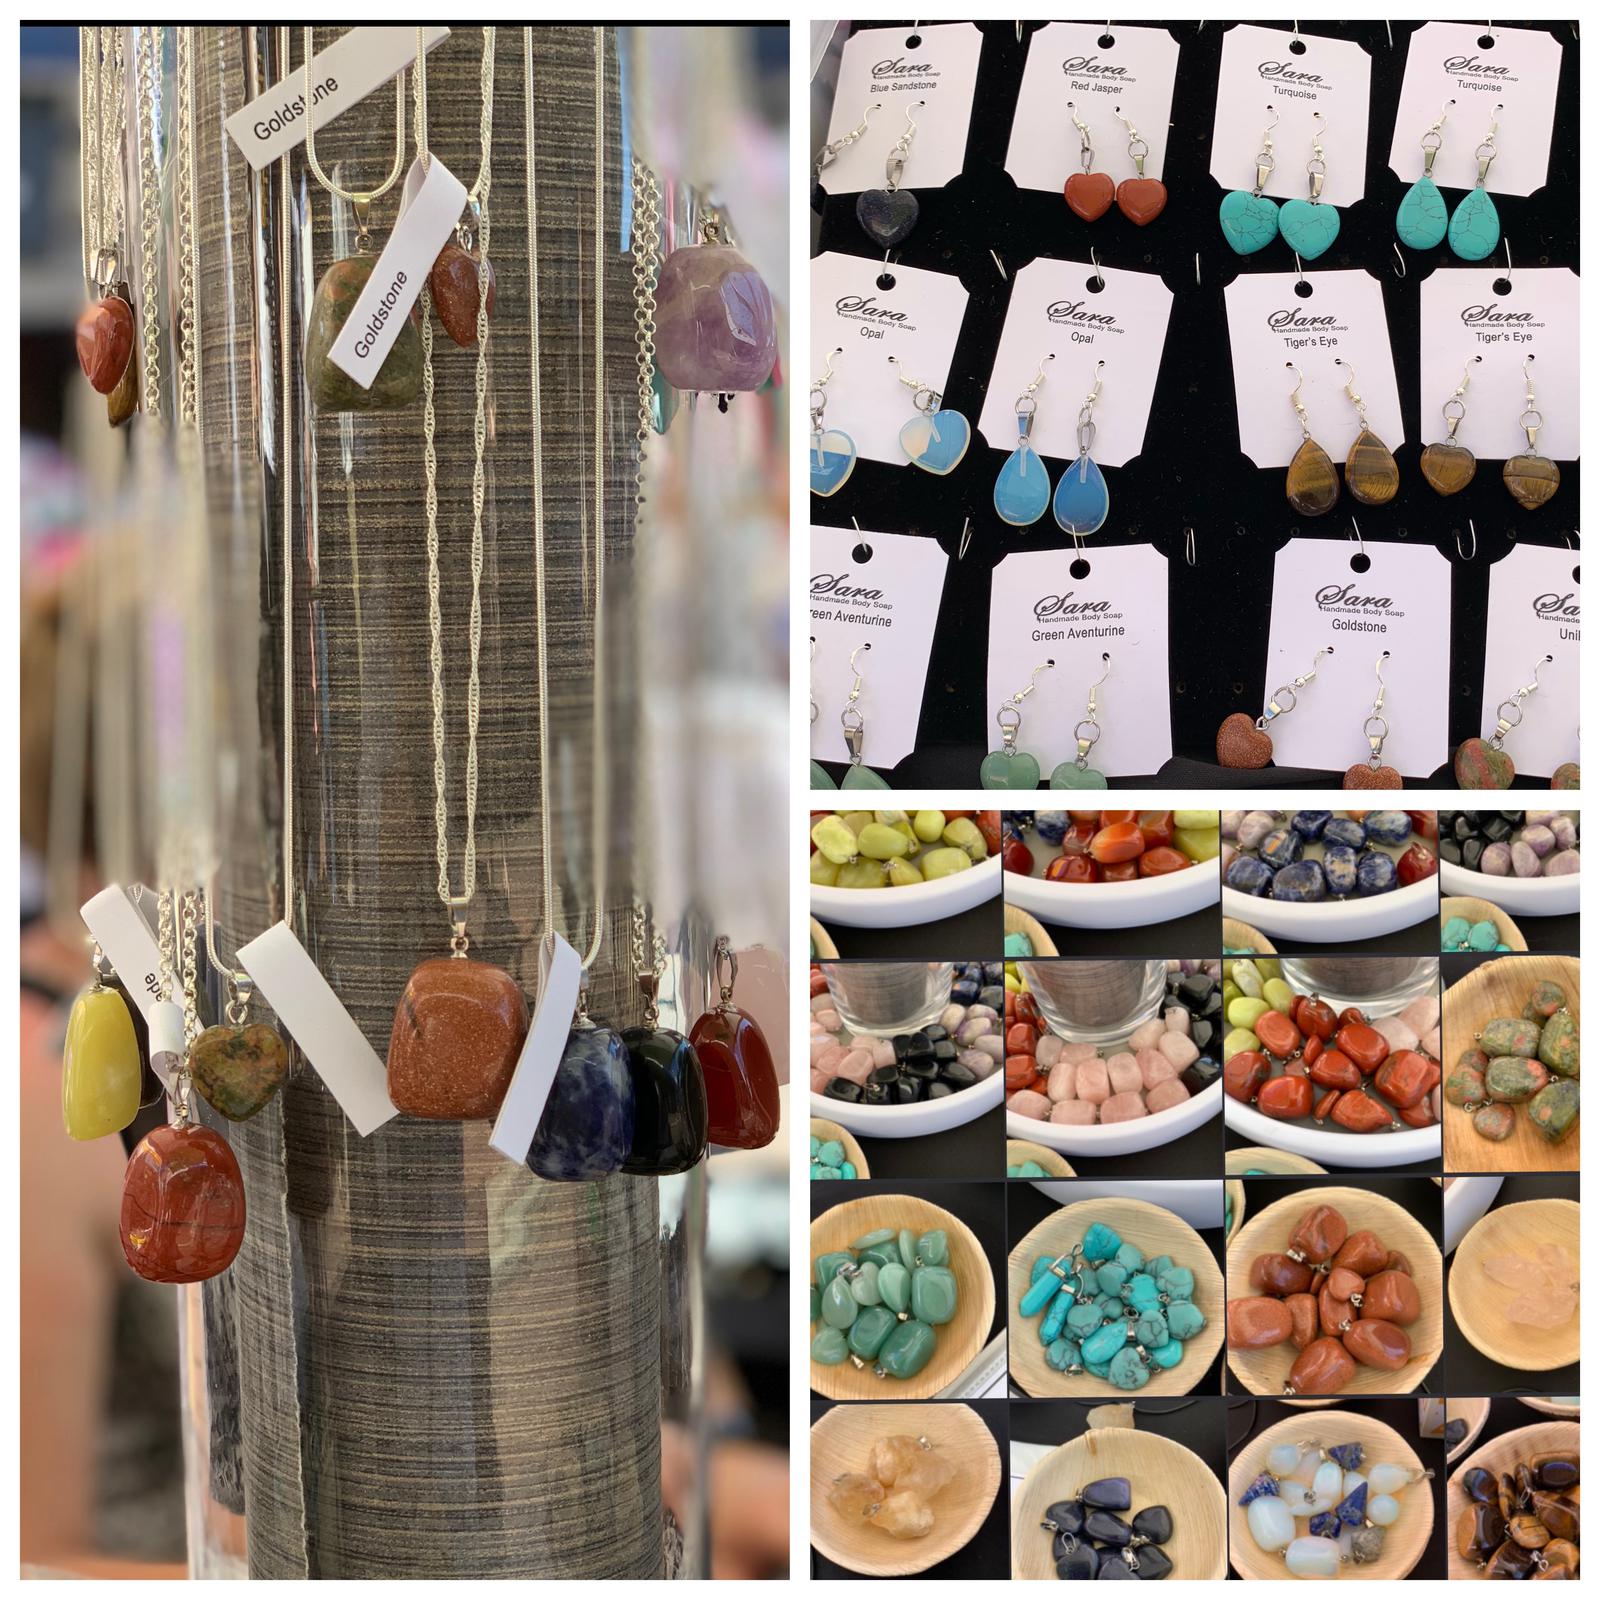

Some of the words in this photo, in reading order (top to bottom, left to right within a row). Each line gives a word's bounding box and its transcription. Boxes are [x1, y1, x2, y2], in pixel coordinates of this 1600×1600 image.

[870, 83, 889, 93] Blue
[891, 81, 937, 91] Sandstone
[1070, 80, 1090, 91] Red
[1091, 83, 1123, 95] Jasper
[1273, 85, 1317, 100] Turquoise
[1457, 79, 1503, 92] Turquoise
[354, 271, 407, 358] Goldstone
[839, 312, 876, 324] Handmade
[878, 318, 897, 328] Body
[898, 322, 917, 332] Soap
[1050, 317, 1086, 328] Handmade
[1087, 322, 1106, 332] Body
[1107, 325, 1125, 334] Soap
[1506, 321, 1524, 329] Body
[1526, 321, 1546, 329] Soap
[860, 326, 885, 340] Opal
[1071, 331, 1095, 344] Opal
[1475, 331, 1510, 344] Tiger's
[1513, 332, 1533, 343] Eye
[1284, 336, 1317, 349] Tiger's
[1319, 336, 1338, 348] Eye
[810, 594, 850, 604] Handmade
[852, 598, 871, 609] Body
[873, 602, 893, 610] Soap
[834, 609, 892, 627] Aventurine
[1038, 614, 1080, 623] Handmade
[1081, 613, 1101, 621] Body
[1103, 611, 1123, 620] Soap
[1319, 605, 1361, 614] Handmade
[1363, 608, 1383, 617] Body
[1384, 609, 1405, 618] Soap
[1331, 618, 1387, 633] Goldstone
[1031, 629, 1065, 641] Green
[1066, 625, 1125, 640] Aventurine
